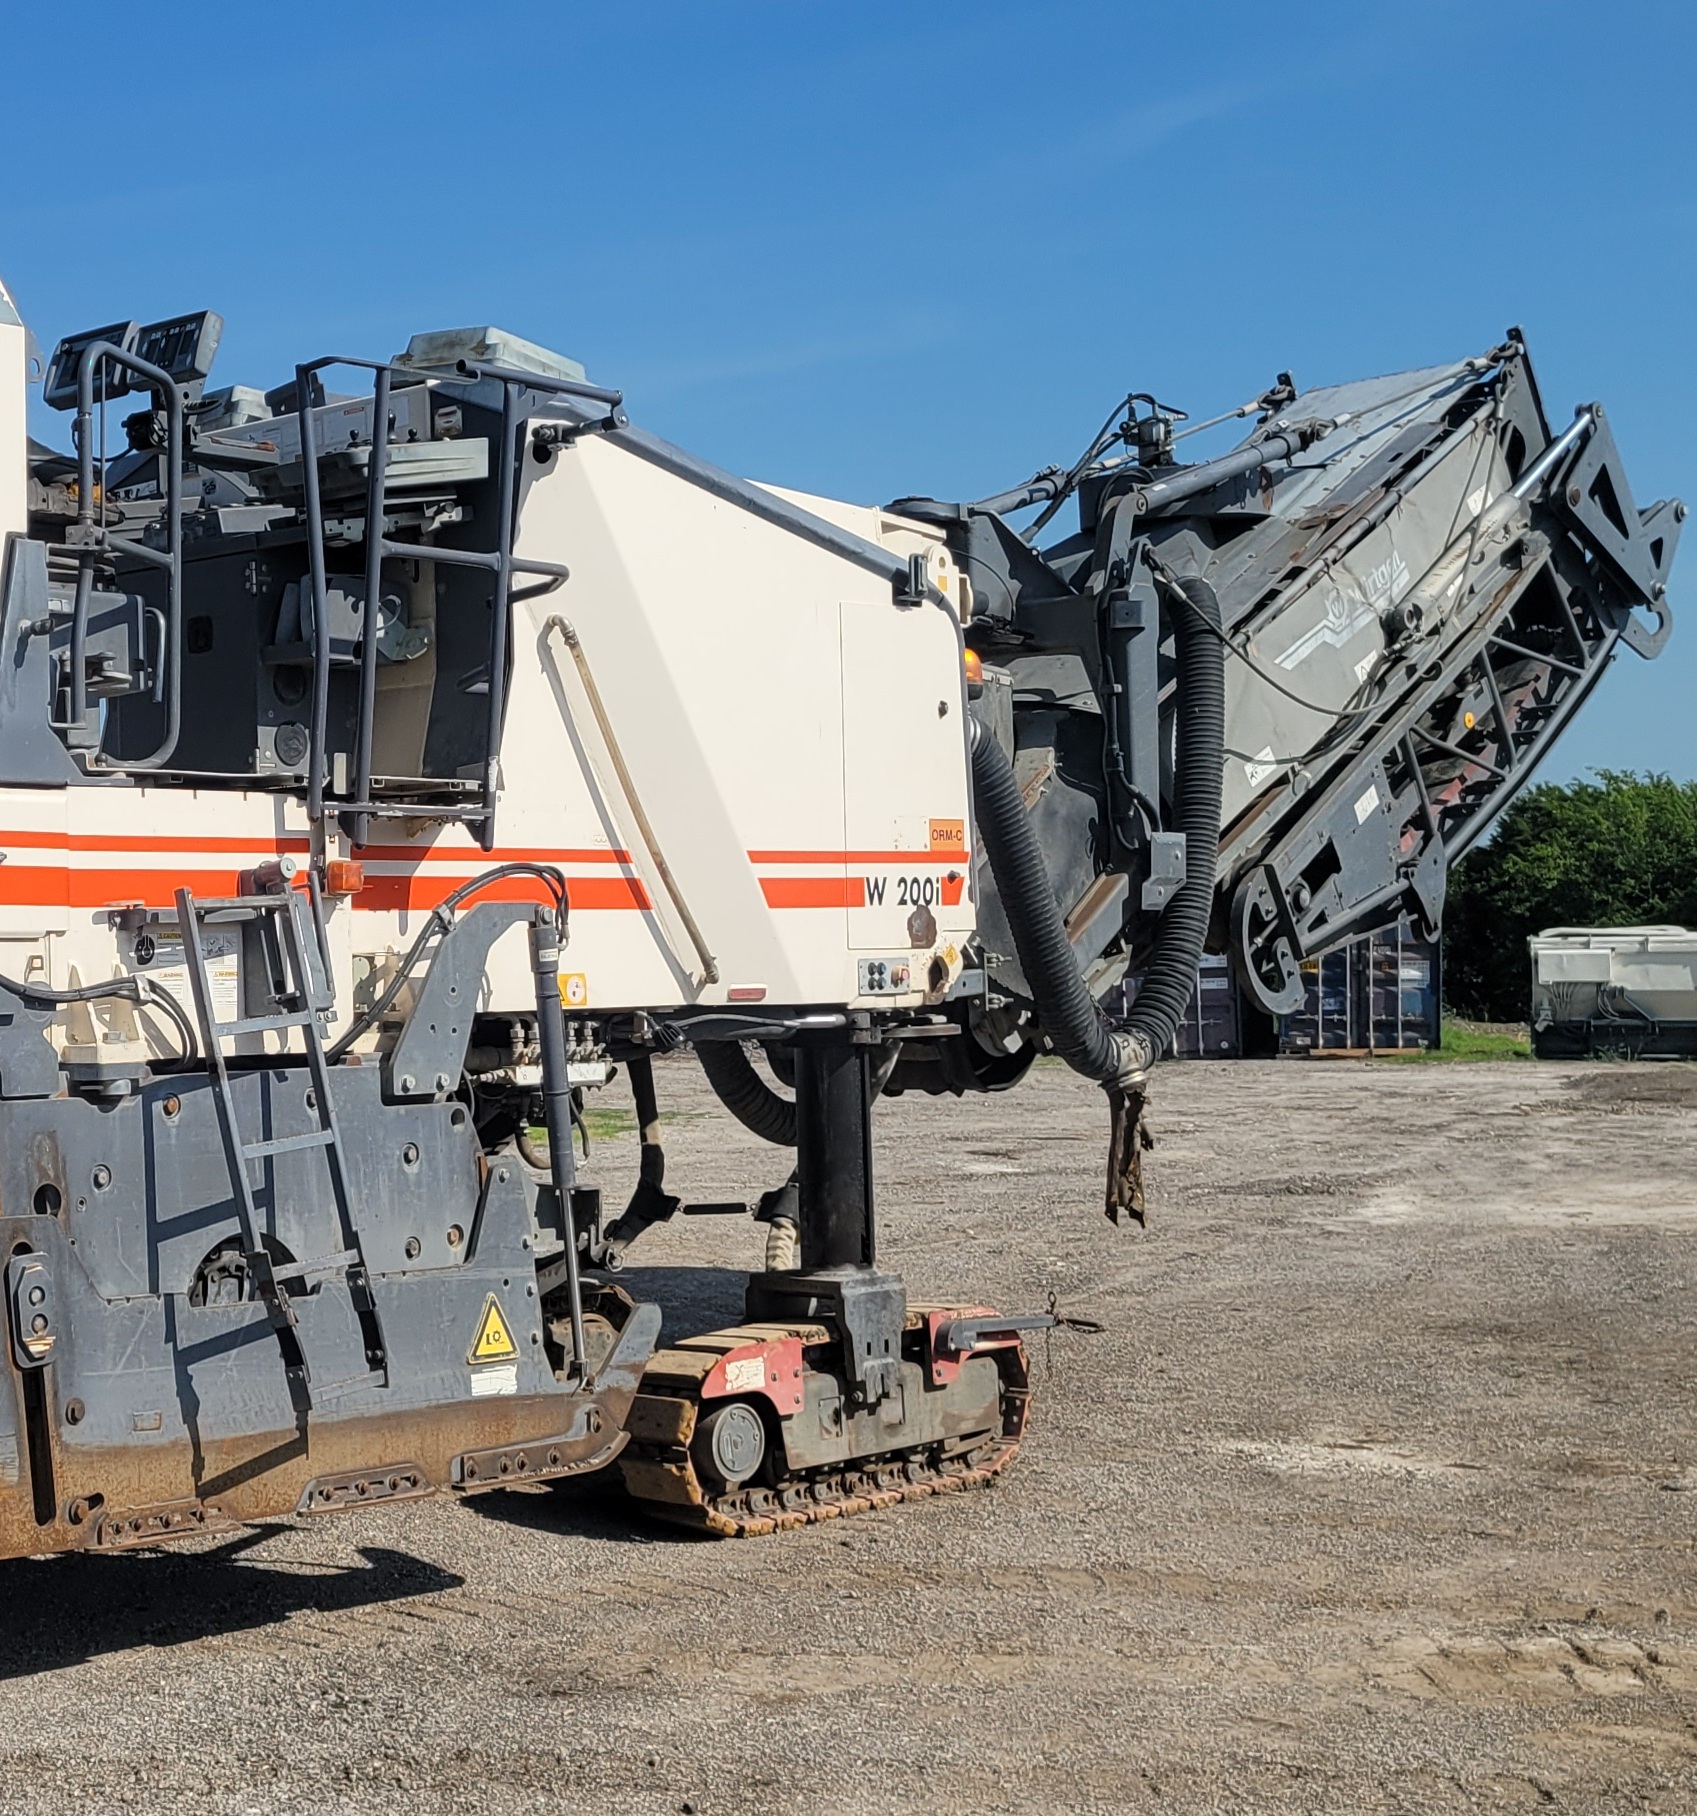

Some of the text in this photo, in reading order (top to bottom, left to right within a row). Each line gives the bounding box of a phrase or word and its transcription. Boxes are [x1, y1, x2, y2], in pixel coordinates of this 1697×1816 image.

[931, 828, 963, 841] ORM-C
[865, 876, 940, 906] W 200i
